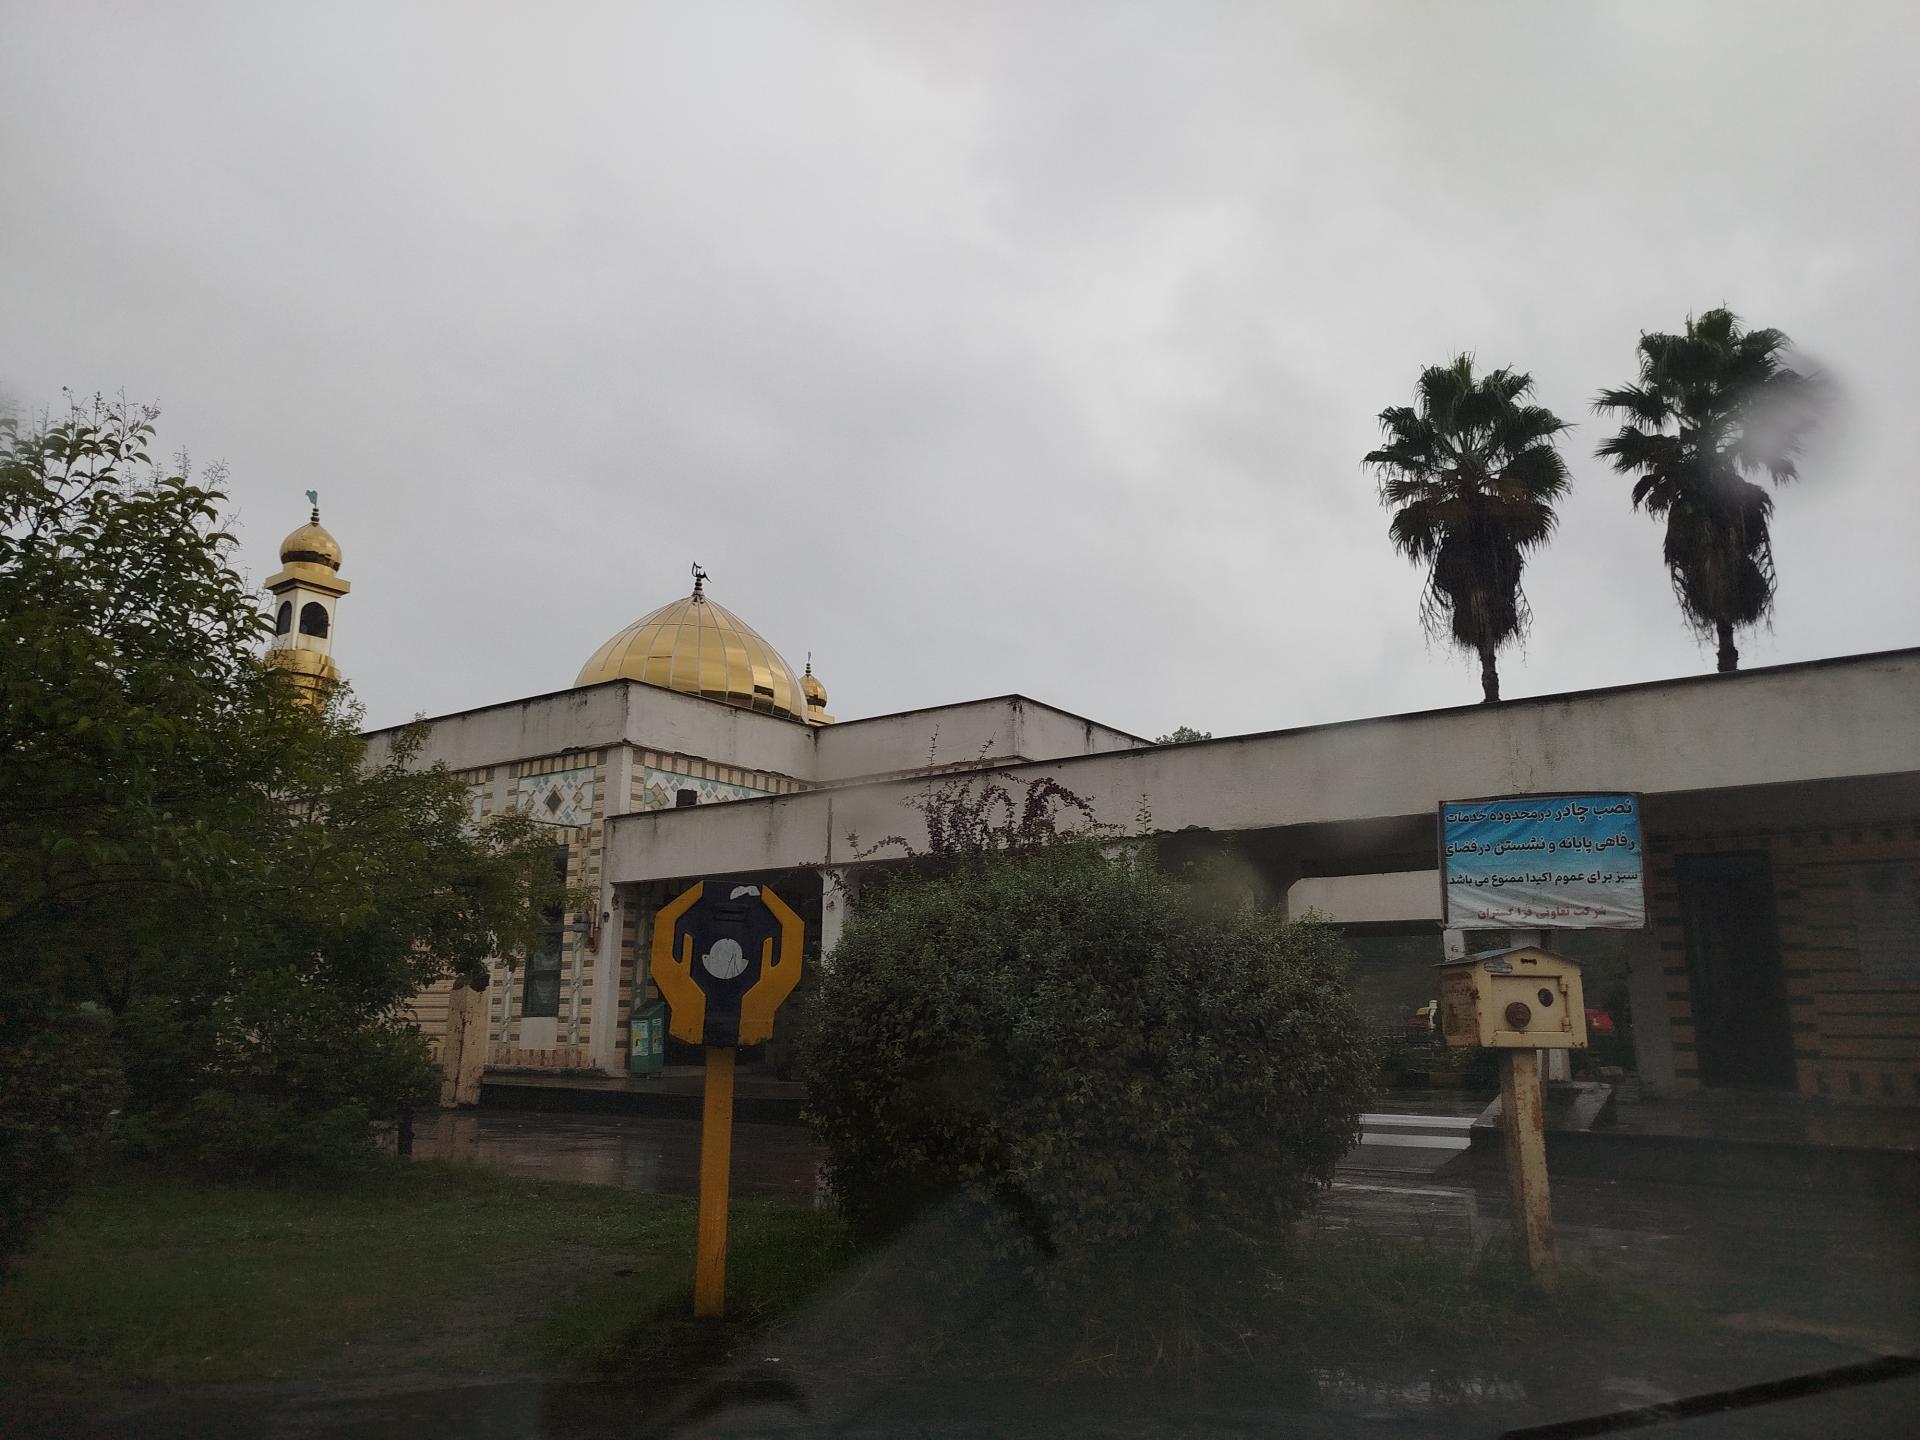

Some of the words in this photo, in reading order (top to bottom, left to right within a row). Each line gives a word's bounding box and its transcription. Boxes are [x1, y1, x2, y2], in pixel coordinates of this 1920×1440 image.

[1554, 802, 1589, 823] چادر
[1592, 799, 1633, 820] نصب
[1446, 810, 1487, 824] خدمات
[1445, 838, 1480, 857] فضای
[1494, 836, 1546, 856] نشستن
[1548, 841, 1556, 853] و
[1558, 834, 1592, 854] پایانه
[1595, 832, 1635, 852] رفاهی
[1449, 874, 1473, 885] باشد
[1475, 876, 1489, 887] می
[1491, 874, 1524, 887] ممنوع
[1525, 872, 1552, 885] اکیدا
[1555, 873, 1585, 886] عموم
[1587, 871, 1613, 884] برای
[1615, 873, 1638, 884] سبز
[1535, 904, 1570, 919] تعاونی
